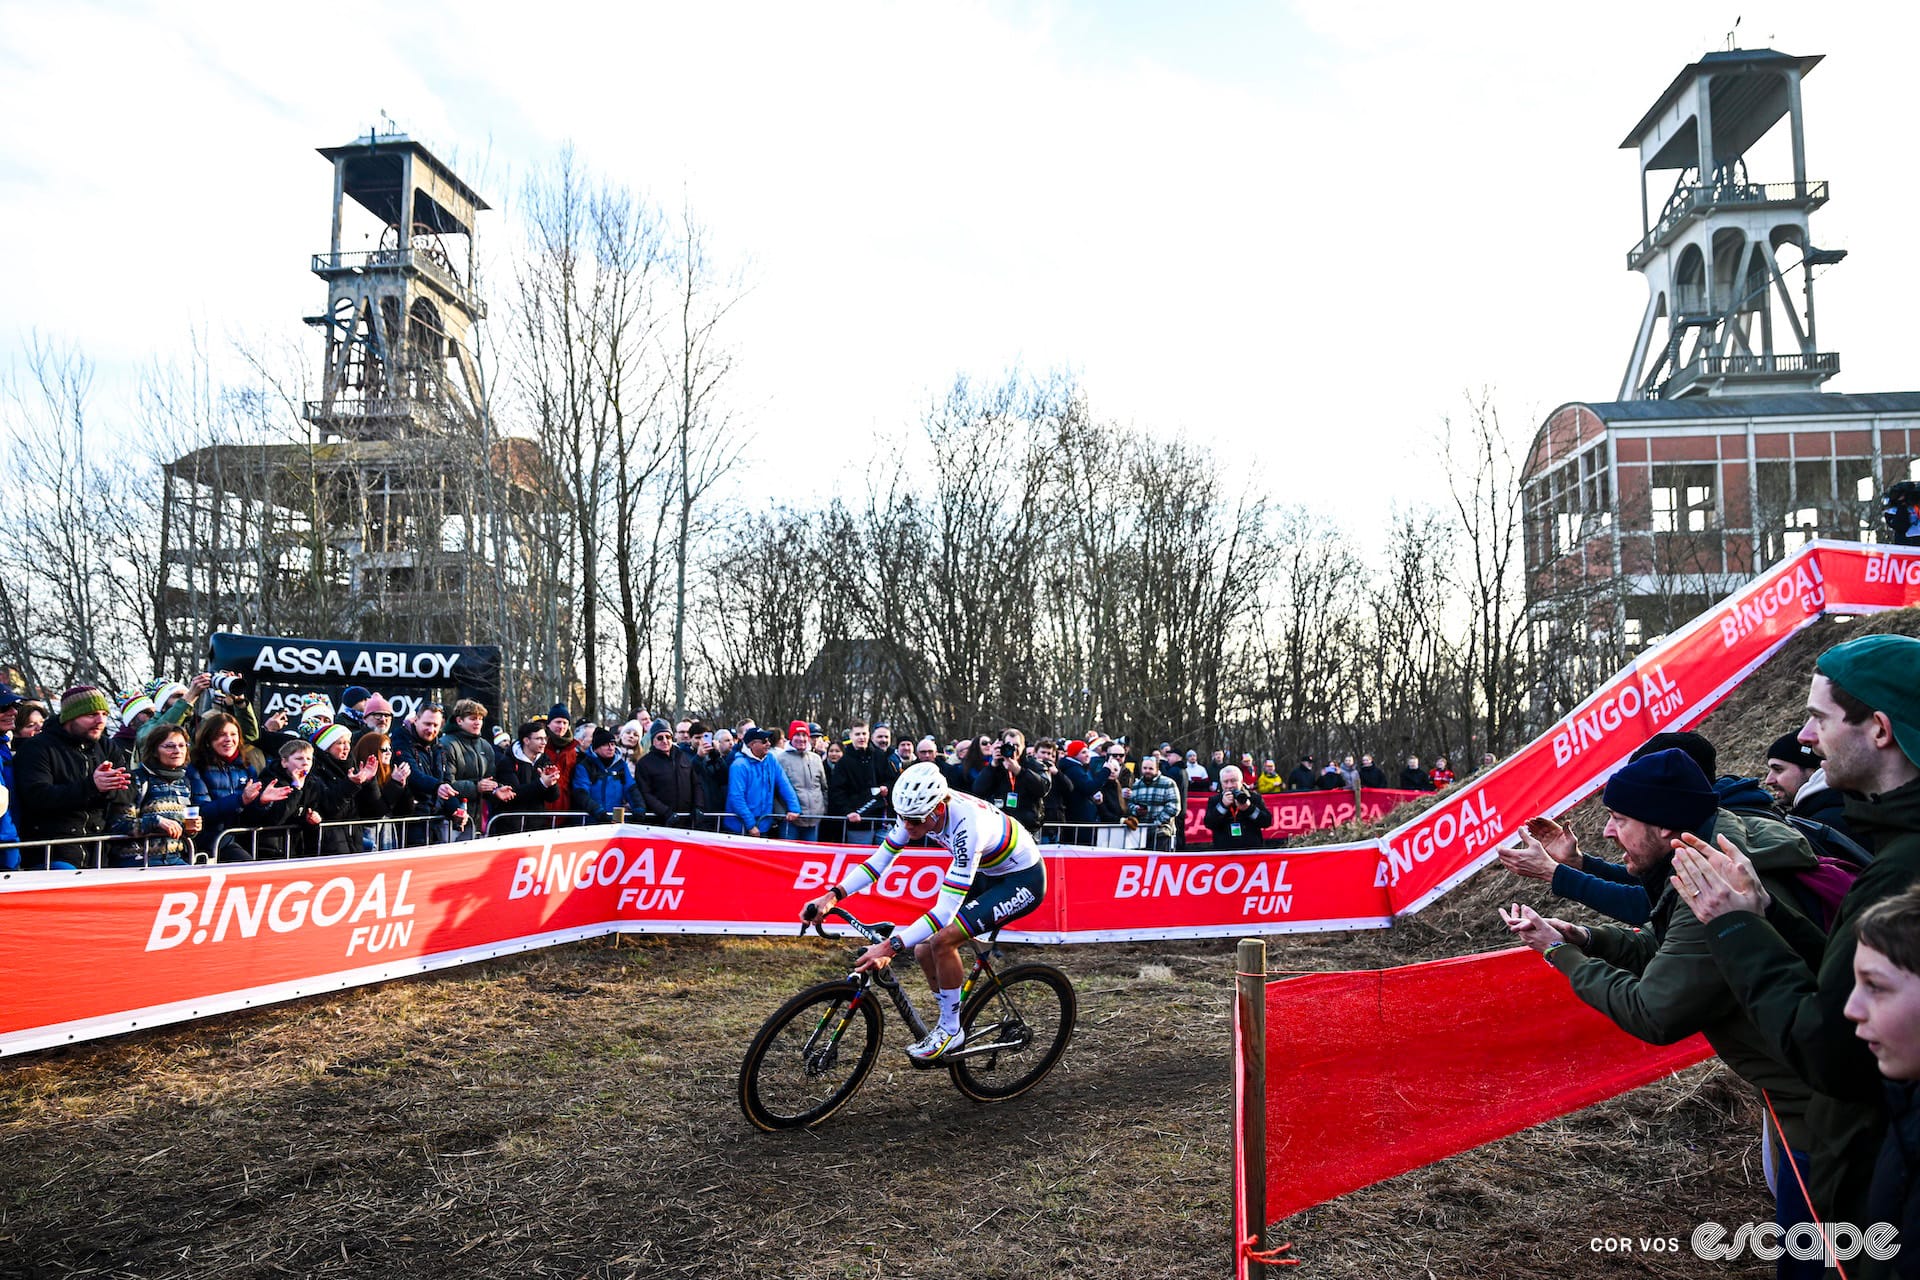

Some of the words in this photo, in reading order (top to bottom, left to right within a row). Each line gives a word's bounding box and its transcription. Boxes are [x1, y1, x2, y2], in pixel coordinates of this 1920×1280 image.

[1865, 552, 1920, 585] B!NG
[1801, 586, 1824, 612] FU
[253, 645, 346, 676] ASSA
[351, 651, 460, 679] ABLOY
[1650, 688, 1684, 724] FUN
[956, 829, 971, 868] Alpecin
[1464, 814, 1503, 855] FUN
[617, 888, 685, 911] FUN
[993, 887, 1034, 921] Alpecin
[1242, 895, 1293, 915] FUN
[345, 919, 415, 957] FUN
